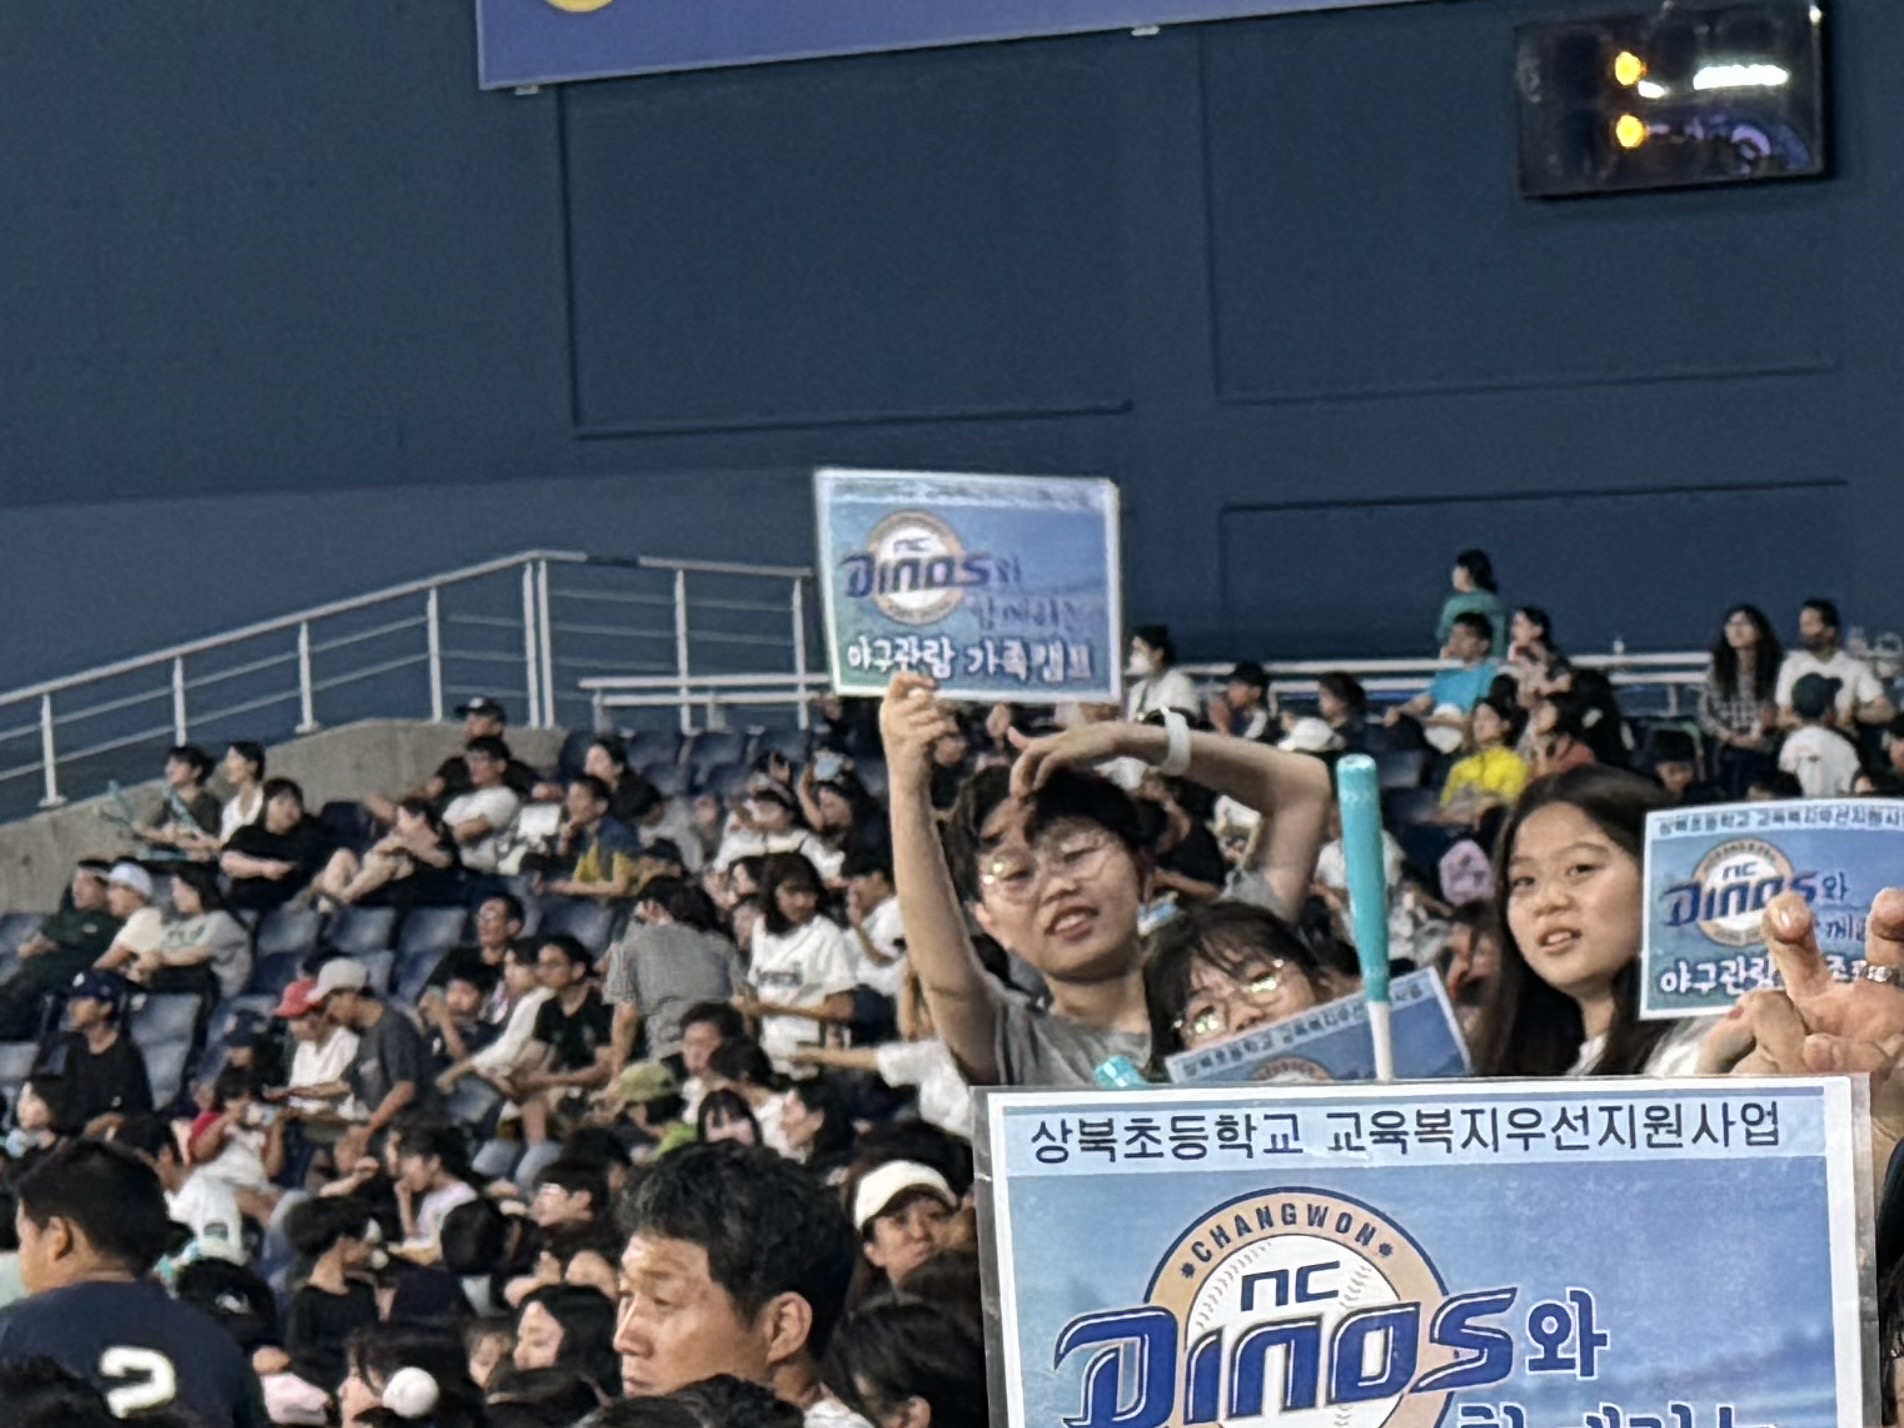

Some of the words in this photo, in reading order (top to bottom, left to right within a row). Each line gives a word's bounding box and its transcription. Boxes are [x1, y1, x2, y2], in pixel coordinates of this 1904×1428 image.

[1030, 1111, 1304, 1164] 상북초등학교
[1326, 1101, 1781, 1156] 교육복지우선지원사업
[1191, 1202, 1376, 1264] CHANGWON
